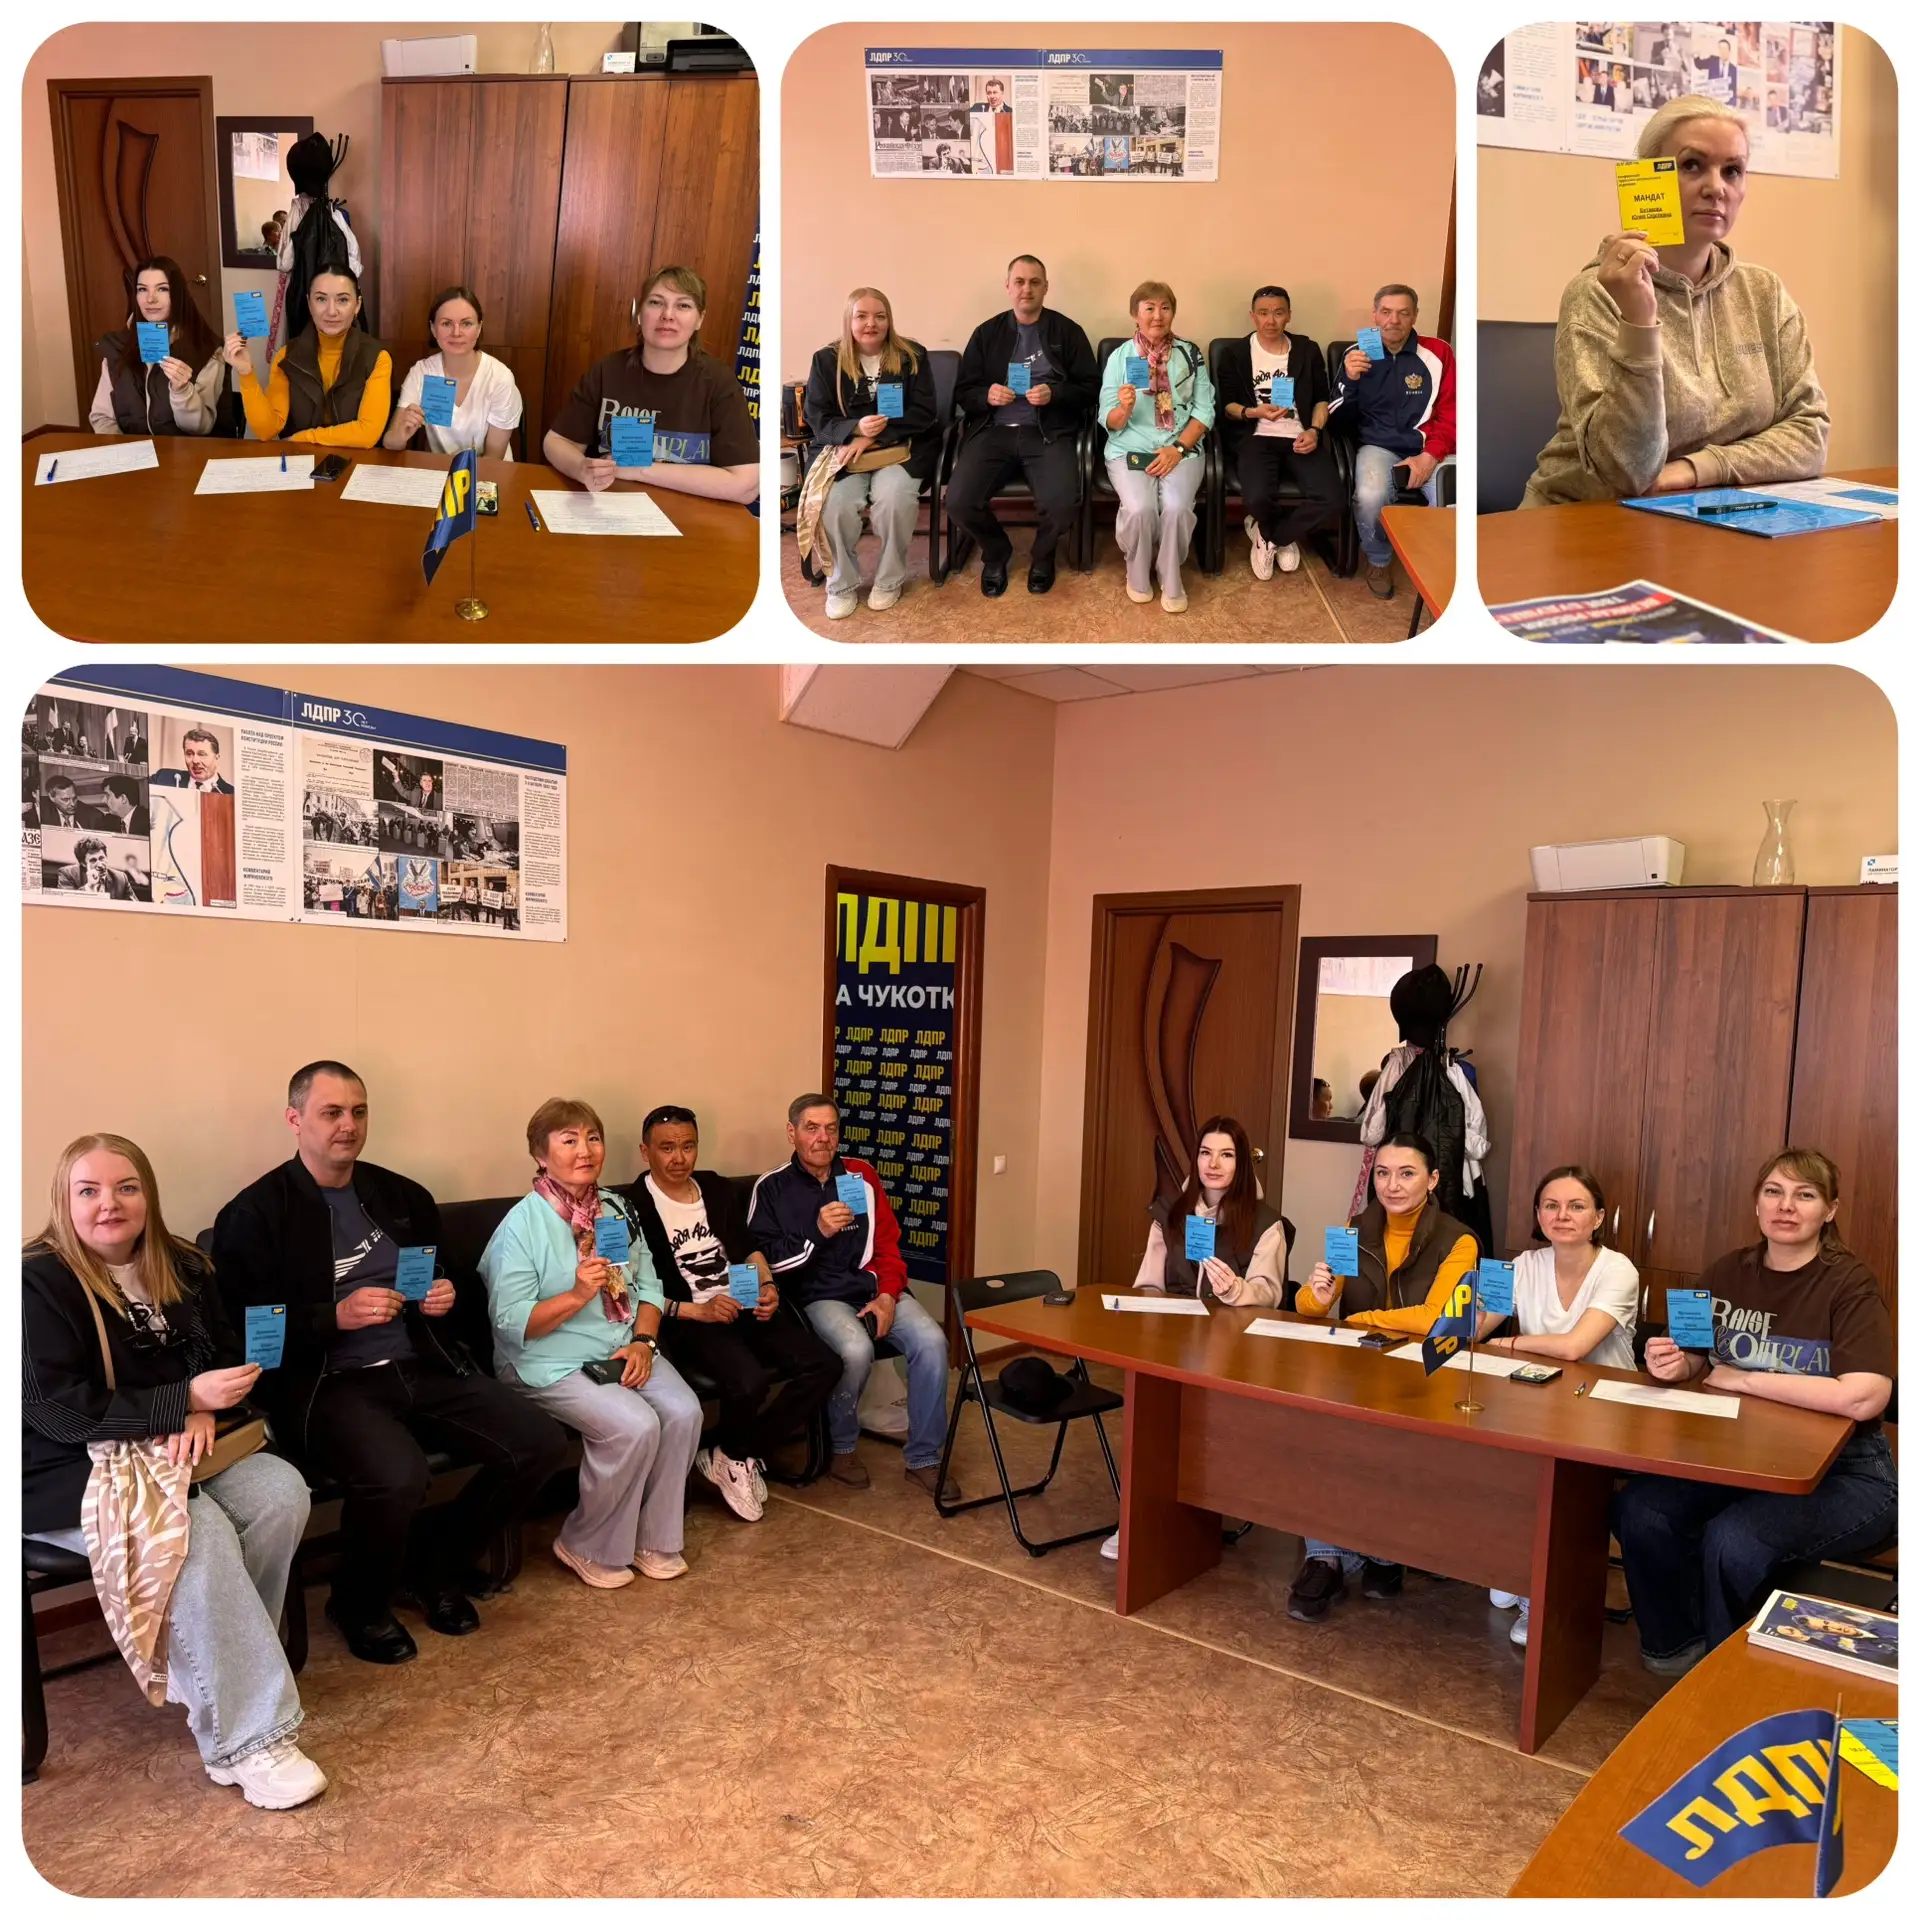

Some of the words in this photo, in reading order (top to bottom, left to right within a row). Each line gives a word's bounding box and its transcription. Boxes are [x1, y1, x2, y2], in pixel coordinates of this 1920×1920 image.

[870, 52, 892, 63] ЛДПР
[1048, 54, 1071, 64] ЛДПР
[1634, 193, 1665, 202] МАНДАТ
[301, 702, 341, 723] ЛДПР
[1711, 1297, 1778, 1341] RAISE
[1666, 1739, 1833, 1860] ЛДП
